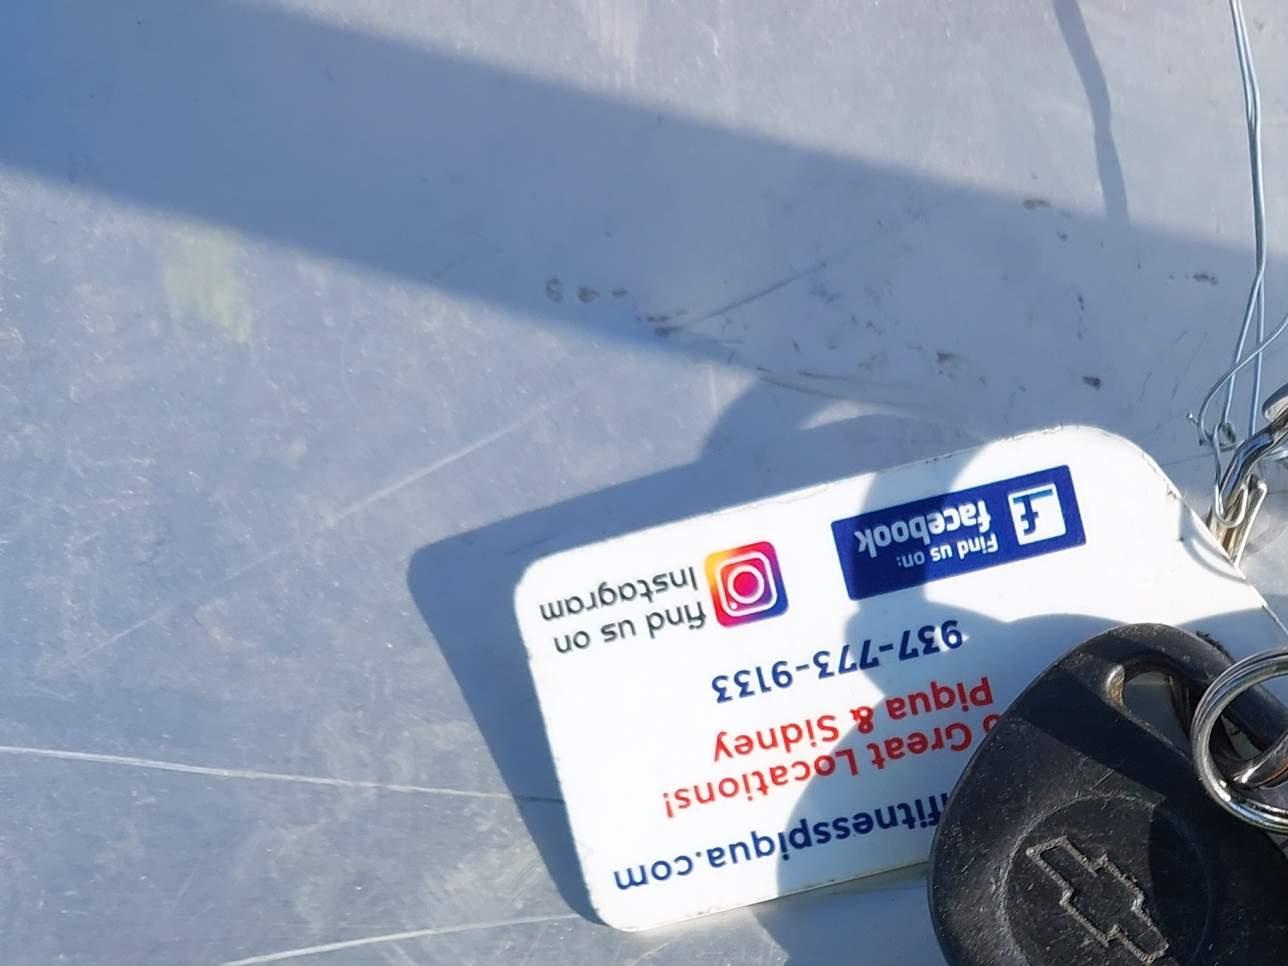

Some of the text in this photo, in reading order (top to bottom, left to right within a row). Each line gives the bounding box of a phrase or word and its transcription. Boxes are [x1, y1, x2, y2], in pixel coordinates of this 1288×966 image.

[854, 499, 993, 559] facebook
[896, 532, 999, 568] Find us on:
[538, 566, 699, 622] Instagram
[553, 600, 708, 654] find us on
[711, 619, 964, 703] 937-773-9133
[713, 676, 994, 762] Piqua & Sidney
[870, 722, 973, 770] Great
[662, 748, 859, 819] Locations!
